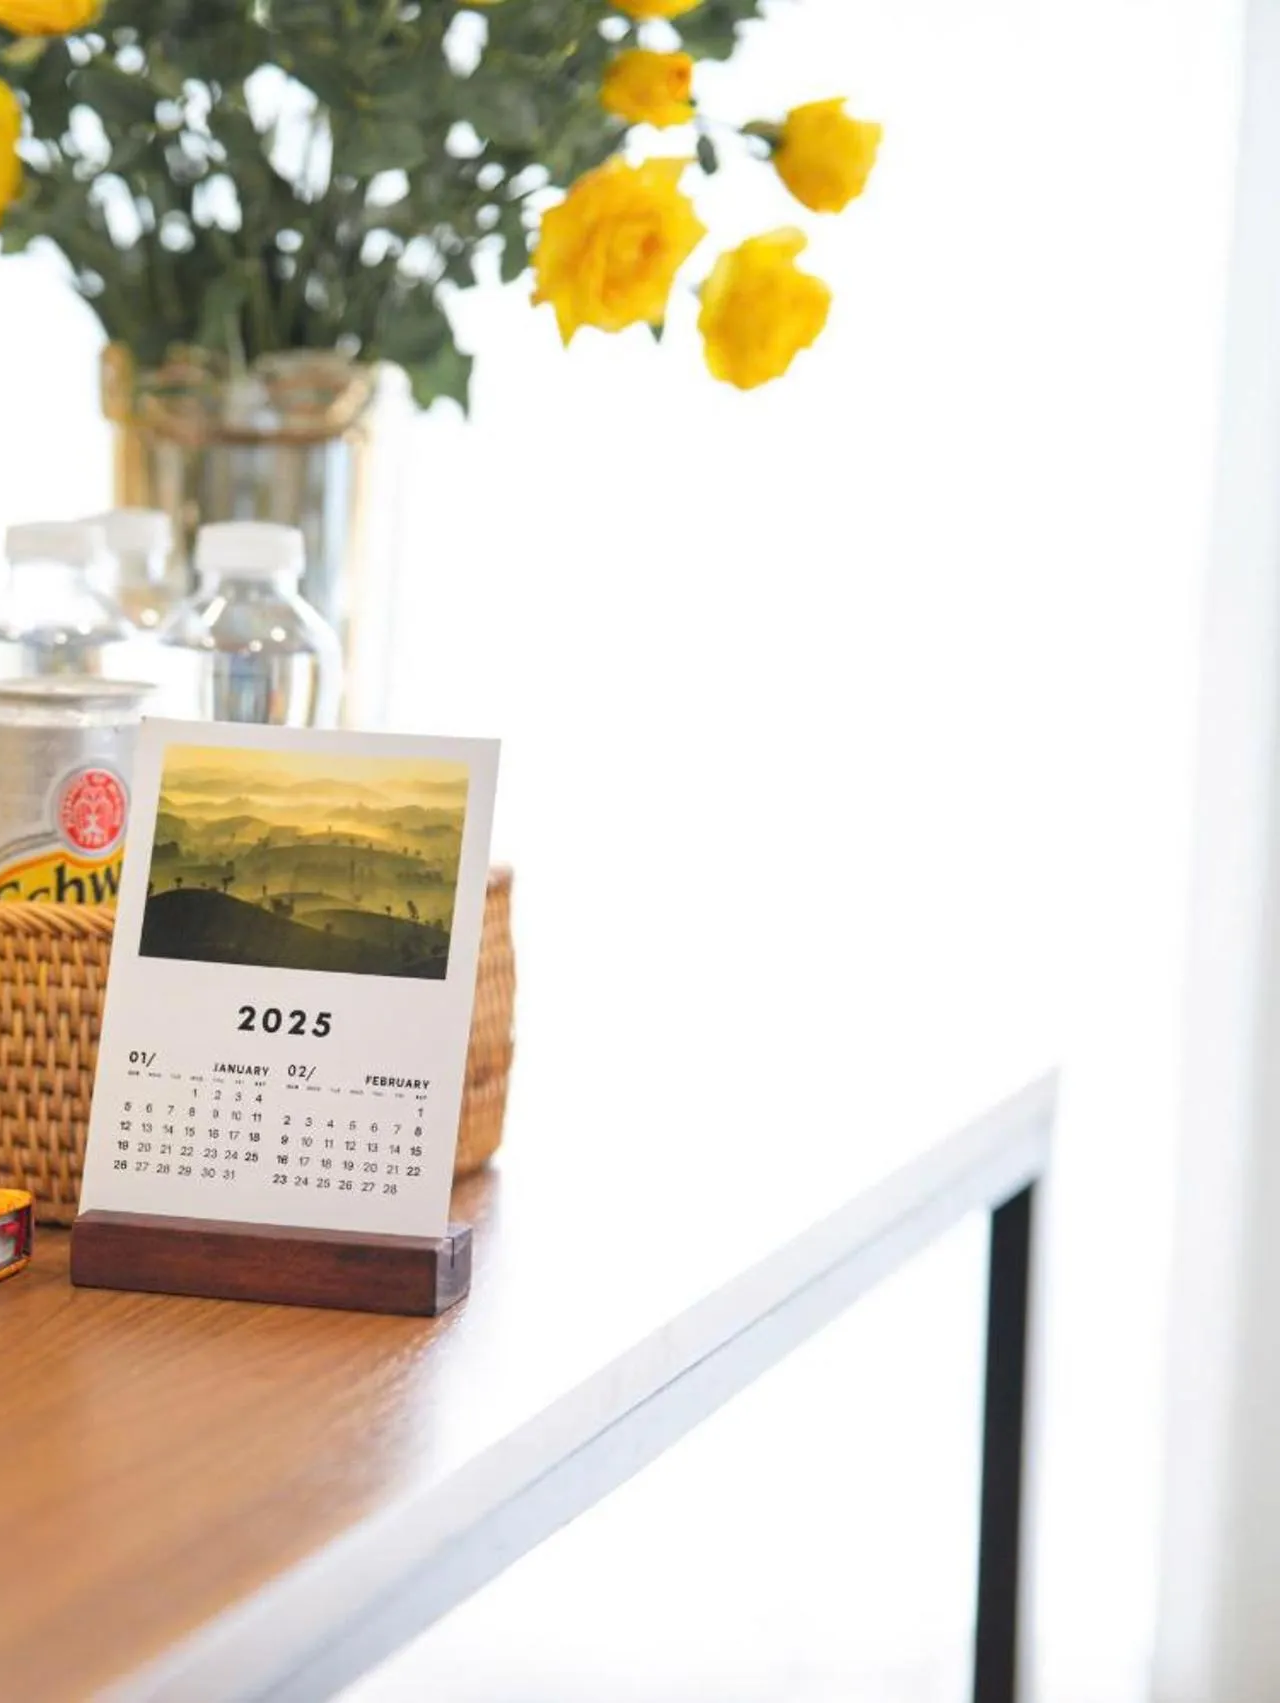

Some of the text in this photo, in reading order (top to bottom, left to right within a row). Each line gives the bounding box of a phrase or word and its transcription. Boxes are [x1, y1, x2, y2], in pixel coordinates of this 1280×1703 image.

[236, 1004, 333, 1039] 2025
[212, 1062, 270, 1077] JANUARY
[364, 1074, 431, 1090] FEBRUARY
[213, 1089, 222, 1101] 2
[234, 1091, 242, 1102] 3
[255, 1093, 263, 1104] 4
[123, 1101, 262, 1123] 5 6 7 8 9 10 11
[119, 1120, 261, 1143] 12 13 14 15 16 17 18
[283, 1114, 423, 1138] 2 3 4 5 6 7 8
[117, 1139, 259, 1163] 19 20 21 22 23 24 25
[280, 1134, 423, 1157] 9 10 11 12 13 14 15
[112, 1159, 235, 1180] 26 27 28 29 30 31
[276, 1154, 421, 1177] 16 17 18 19 20 21 22
[272, 1173, 398, 1196] 23 24 25 26 27 28
